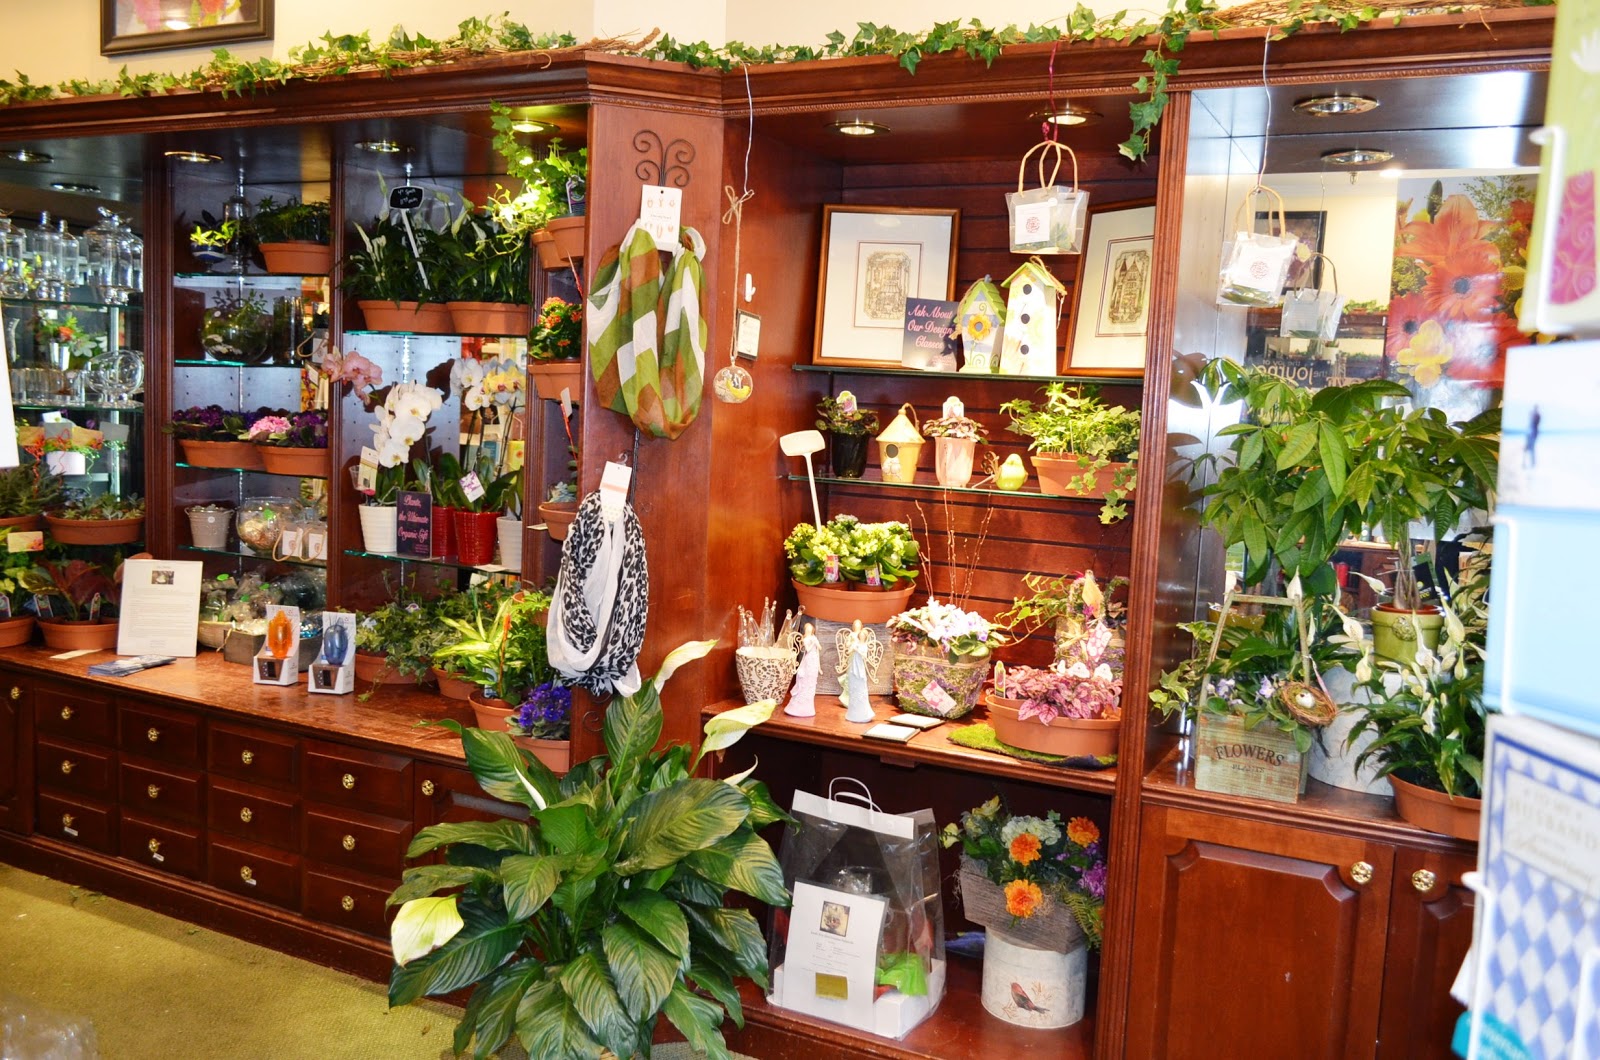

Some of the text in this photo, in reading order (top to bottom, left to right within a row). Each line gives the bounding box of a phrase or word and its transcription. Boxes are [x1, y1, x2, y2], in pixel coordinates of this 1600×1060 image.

[908, 304, 953, 319] Ask About
[907, 319, 953, 338] Our Design
[916, 335, 944, 349] Classes
[1215, 744, 1285, 767] FLOWERS
